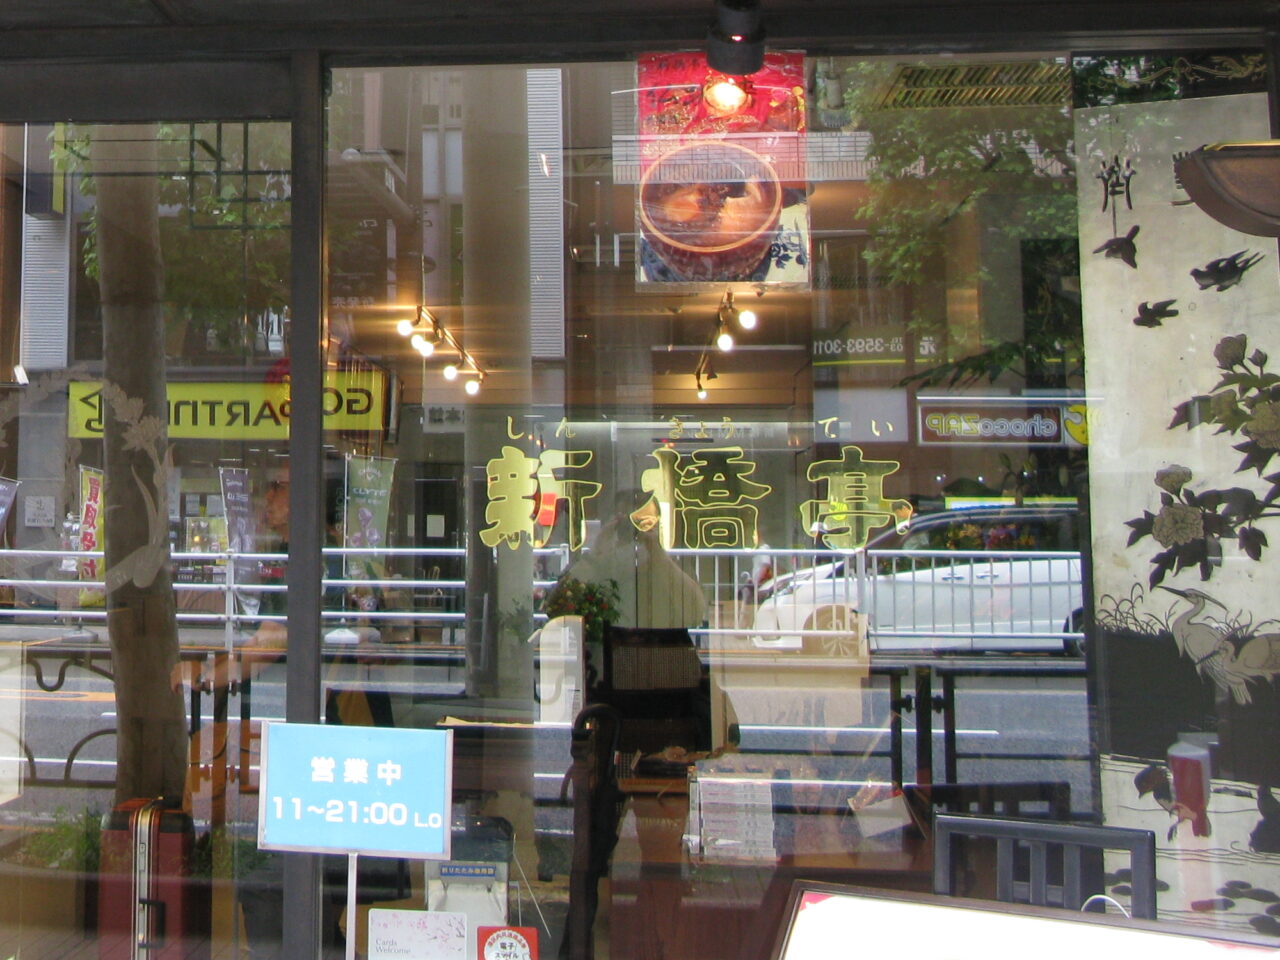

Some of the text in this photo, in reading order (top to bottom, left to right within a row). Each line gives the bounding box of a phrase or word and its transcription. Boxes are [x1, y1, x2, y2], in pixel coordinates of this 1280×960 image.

[478, 445, 913, 551] 新橋亭
[310, 756, 403, 786] 営業中
[375, 938, 397, 946] Cards
[375, 945, 411, 954] Welcome
